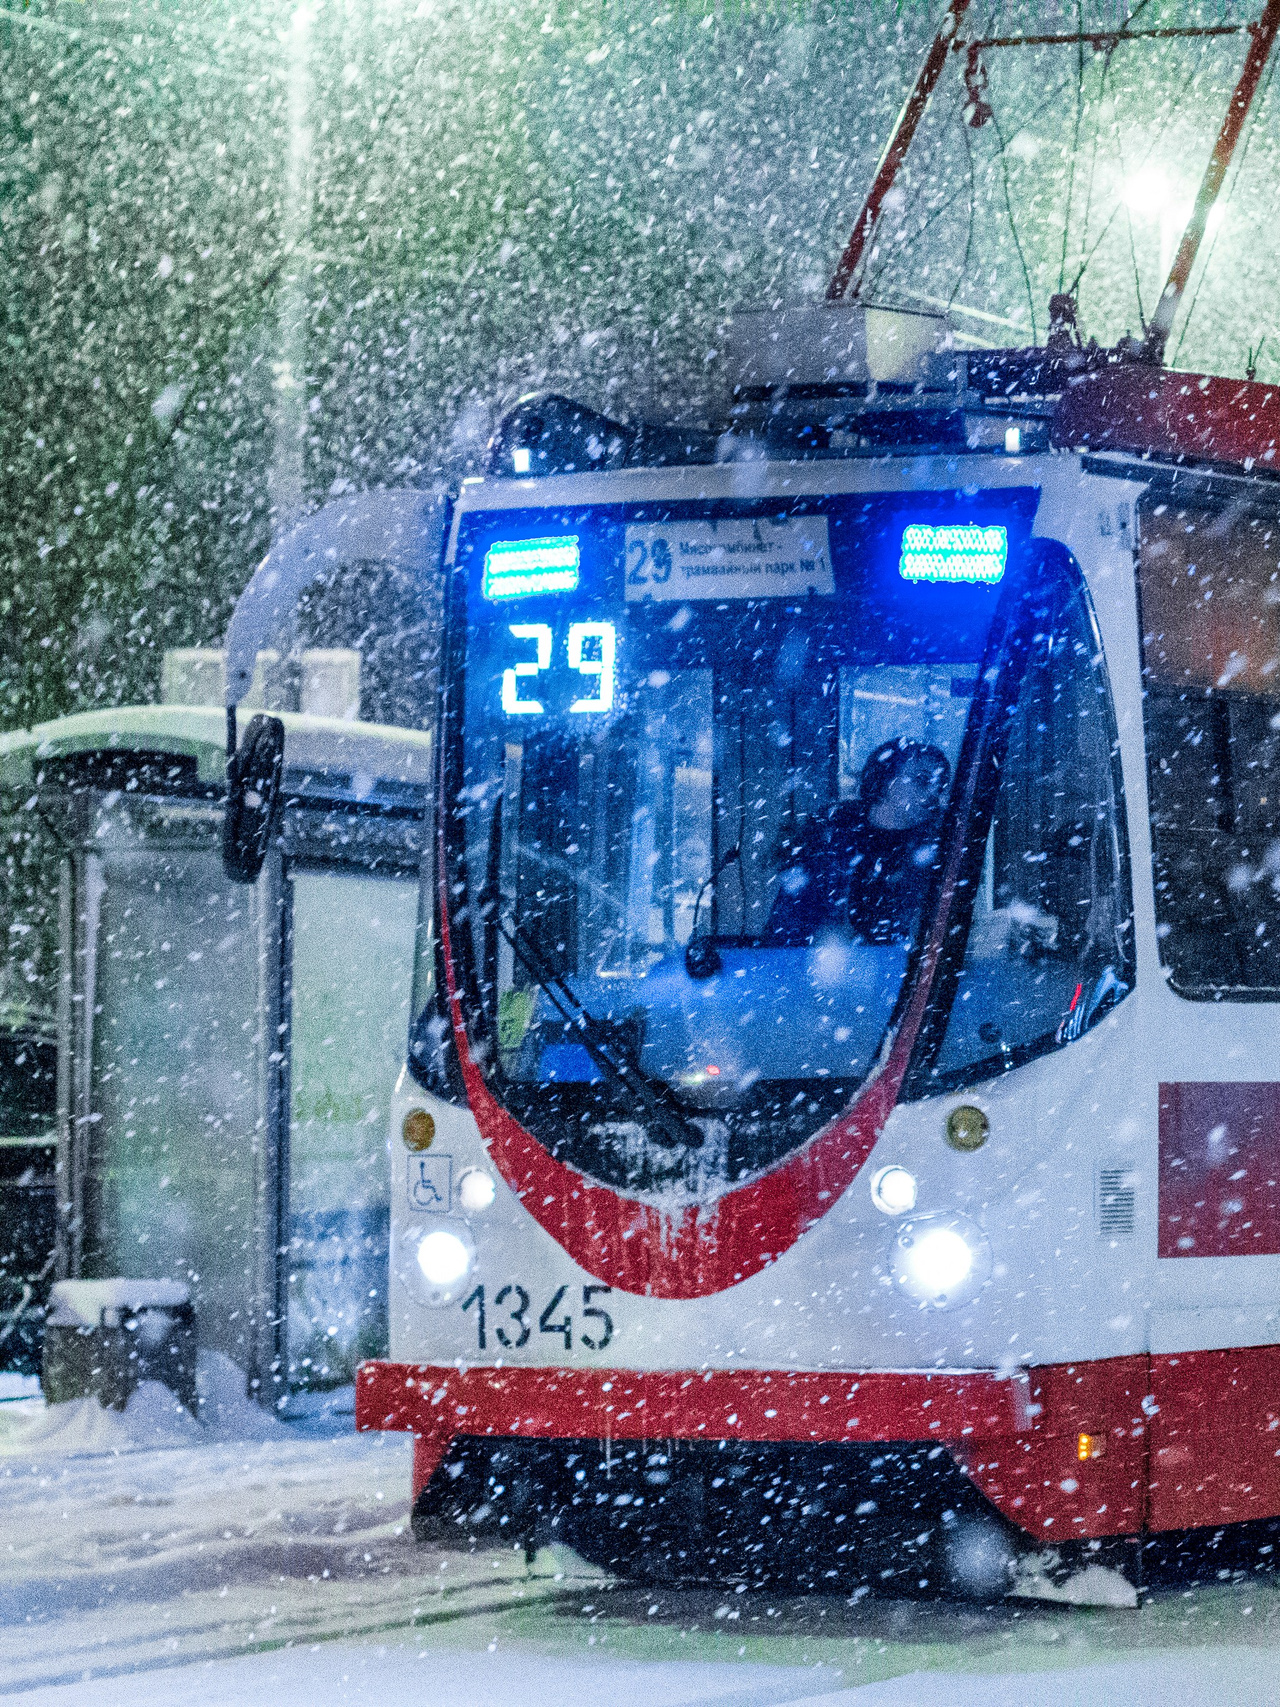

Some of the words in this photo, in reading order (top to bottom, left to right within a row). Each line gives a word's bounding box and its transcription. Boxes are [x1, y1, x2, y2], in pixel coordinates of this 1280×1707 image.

[627, 538, 672, 585] 29
[680, 562, 761, 579] трамвайный
[765, 561, 796, 577] парк
[502, 622, 616, 715] 29
[461, 1284, 614, 1350] 1345
